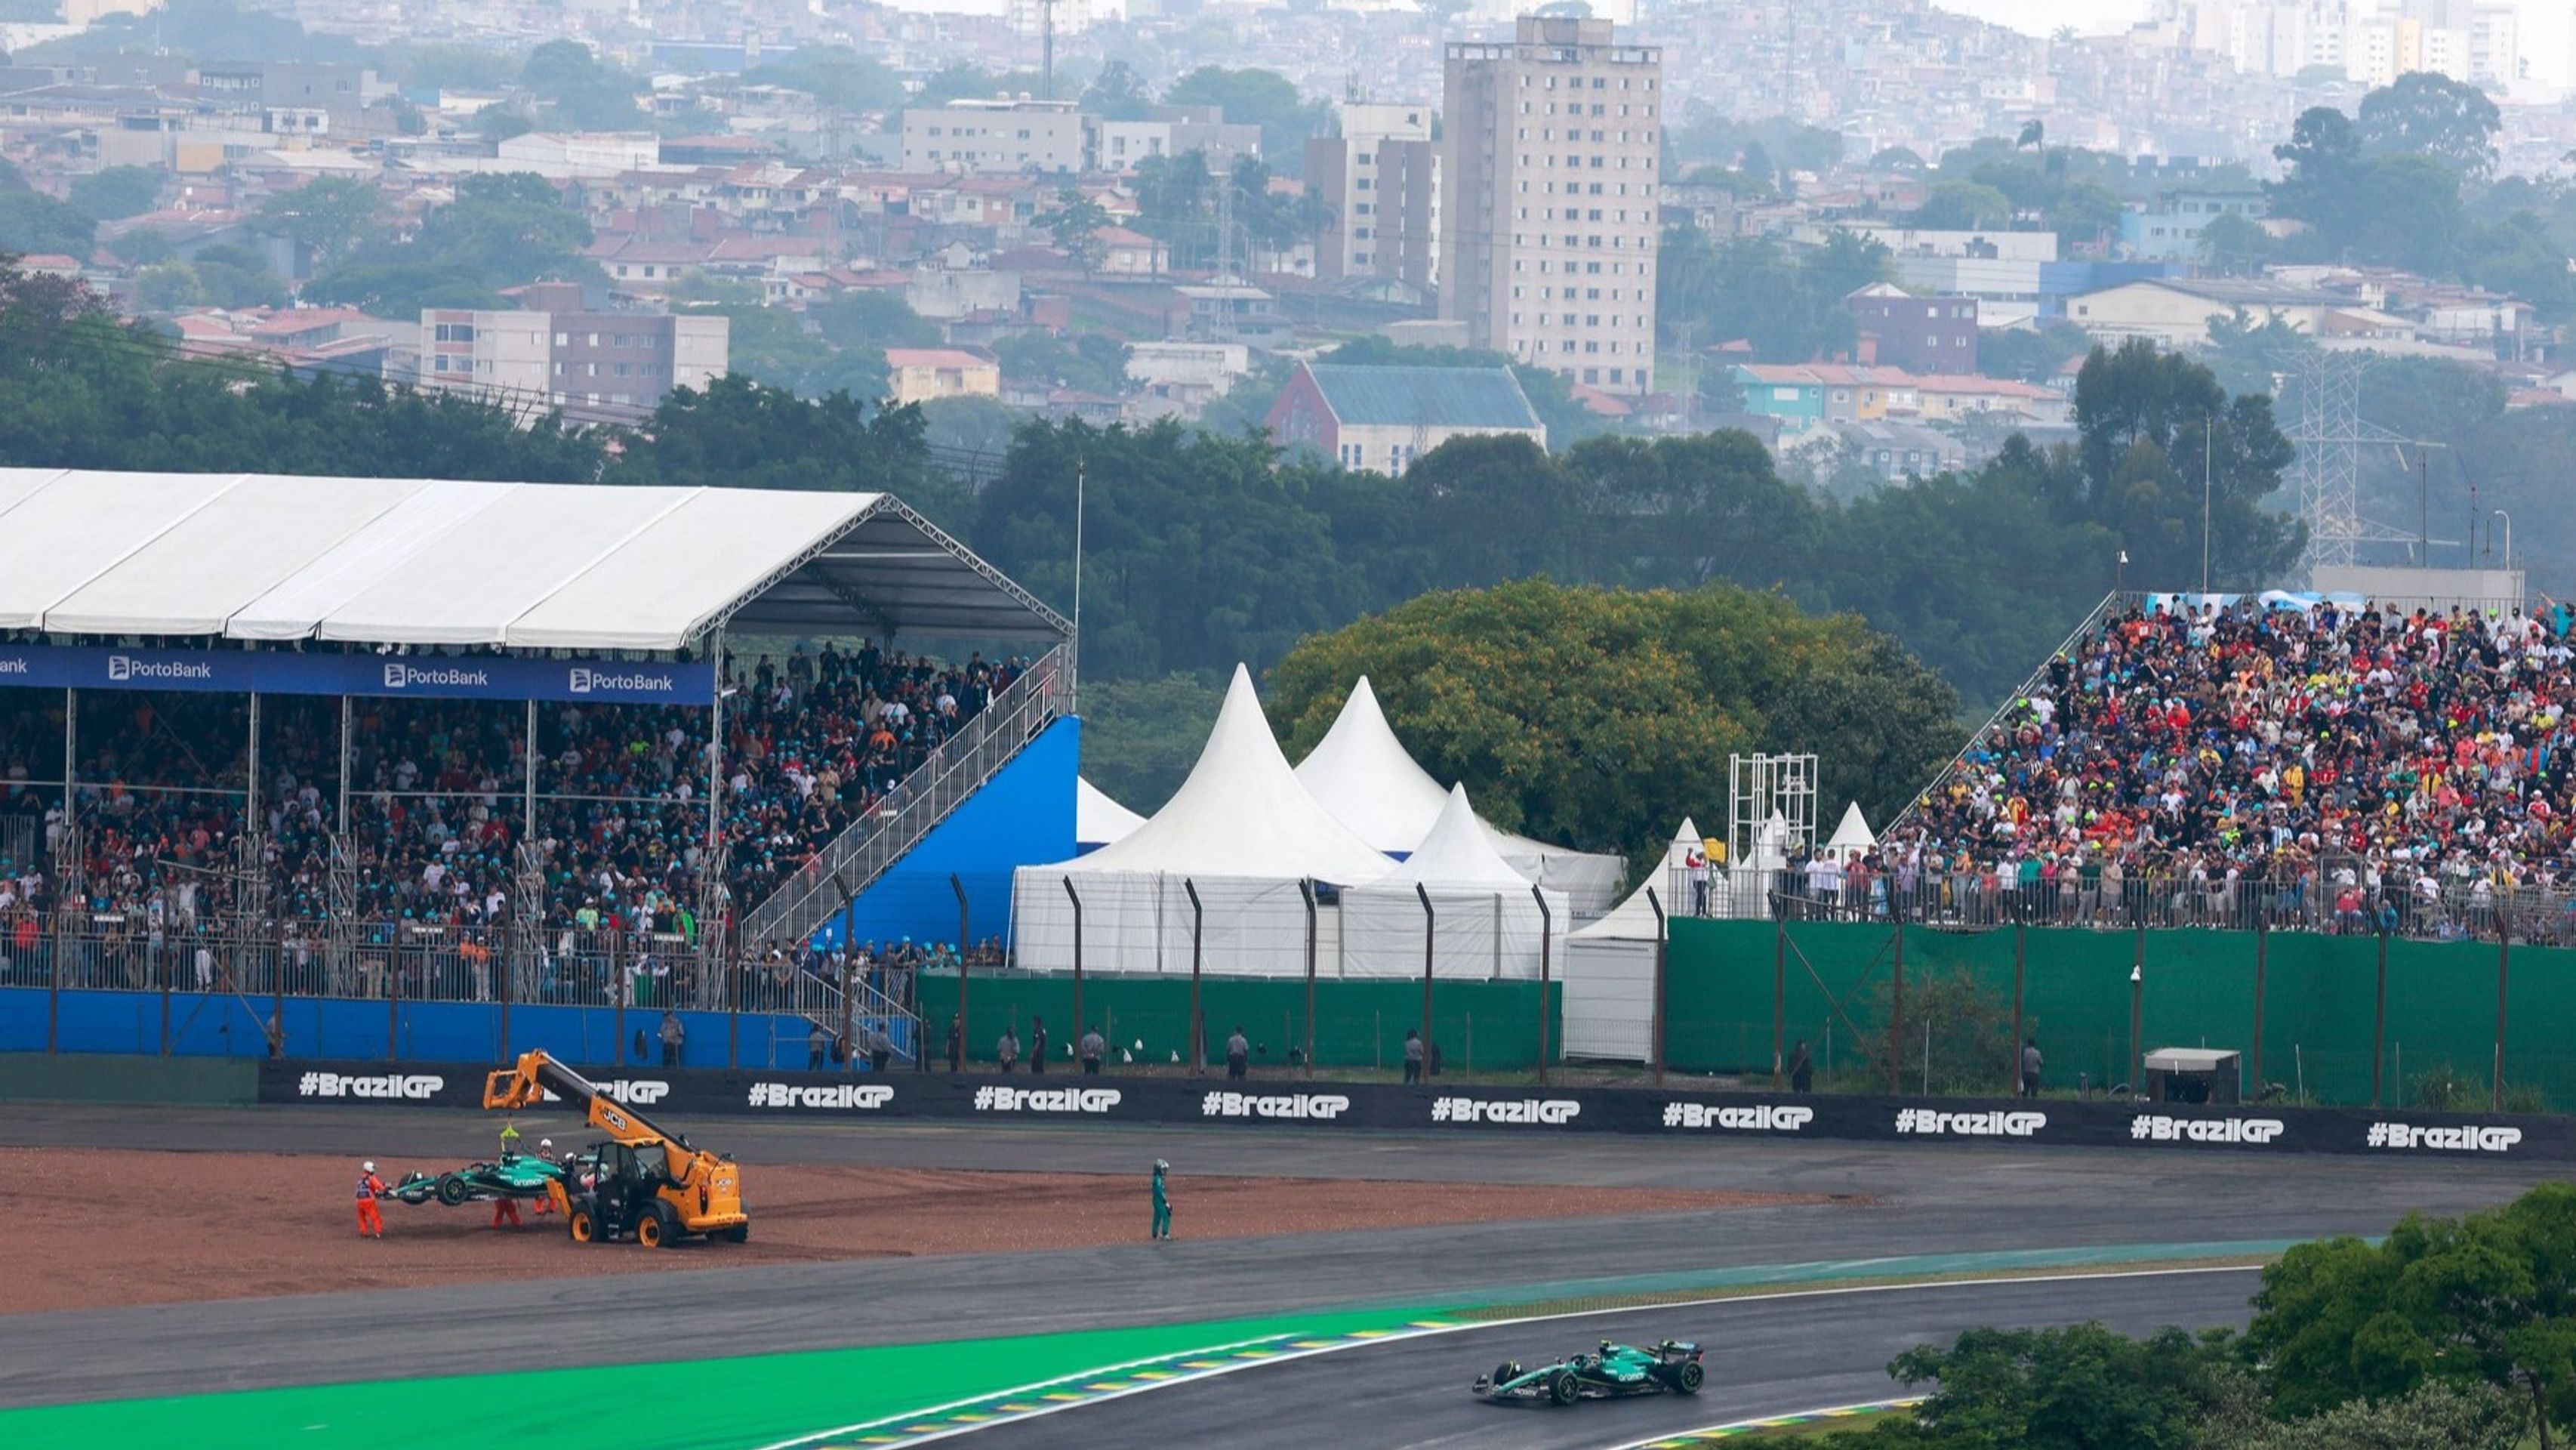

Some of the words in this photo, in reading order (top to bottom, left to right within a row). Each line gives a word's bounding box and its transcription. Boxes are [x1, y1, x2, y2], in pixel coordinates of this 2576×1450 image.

[131, 661, 211, 678] PortoBank
[408, 668, 488, 686] PortoBank
[593, 674, 673, 692] PortoBank
[298, 1072, 444, 1099] #BrazilGP
[748, 1082, 894, 1109] #BrazilGP
[974, 1086, 1121, 1112] #BrazilGP
[1202, 1091, 1350, 1118] #BrazilGP
[1431, 1097, 1581, 1124] #BrazilGP
[1662, 1102, 1813, 1130] #BrazilGP
[603, 1107, 627, 1131] JCB
[1895, 1108, 2047, 1136] #BrazilGP
[2131, 1115, 2284, 1143] #BrazilGP
[2367, 1122, 2522, 1152] #BrazilGP
